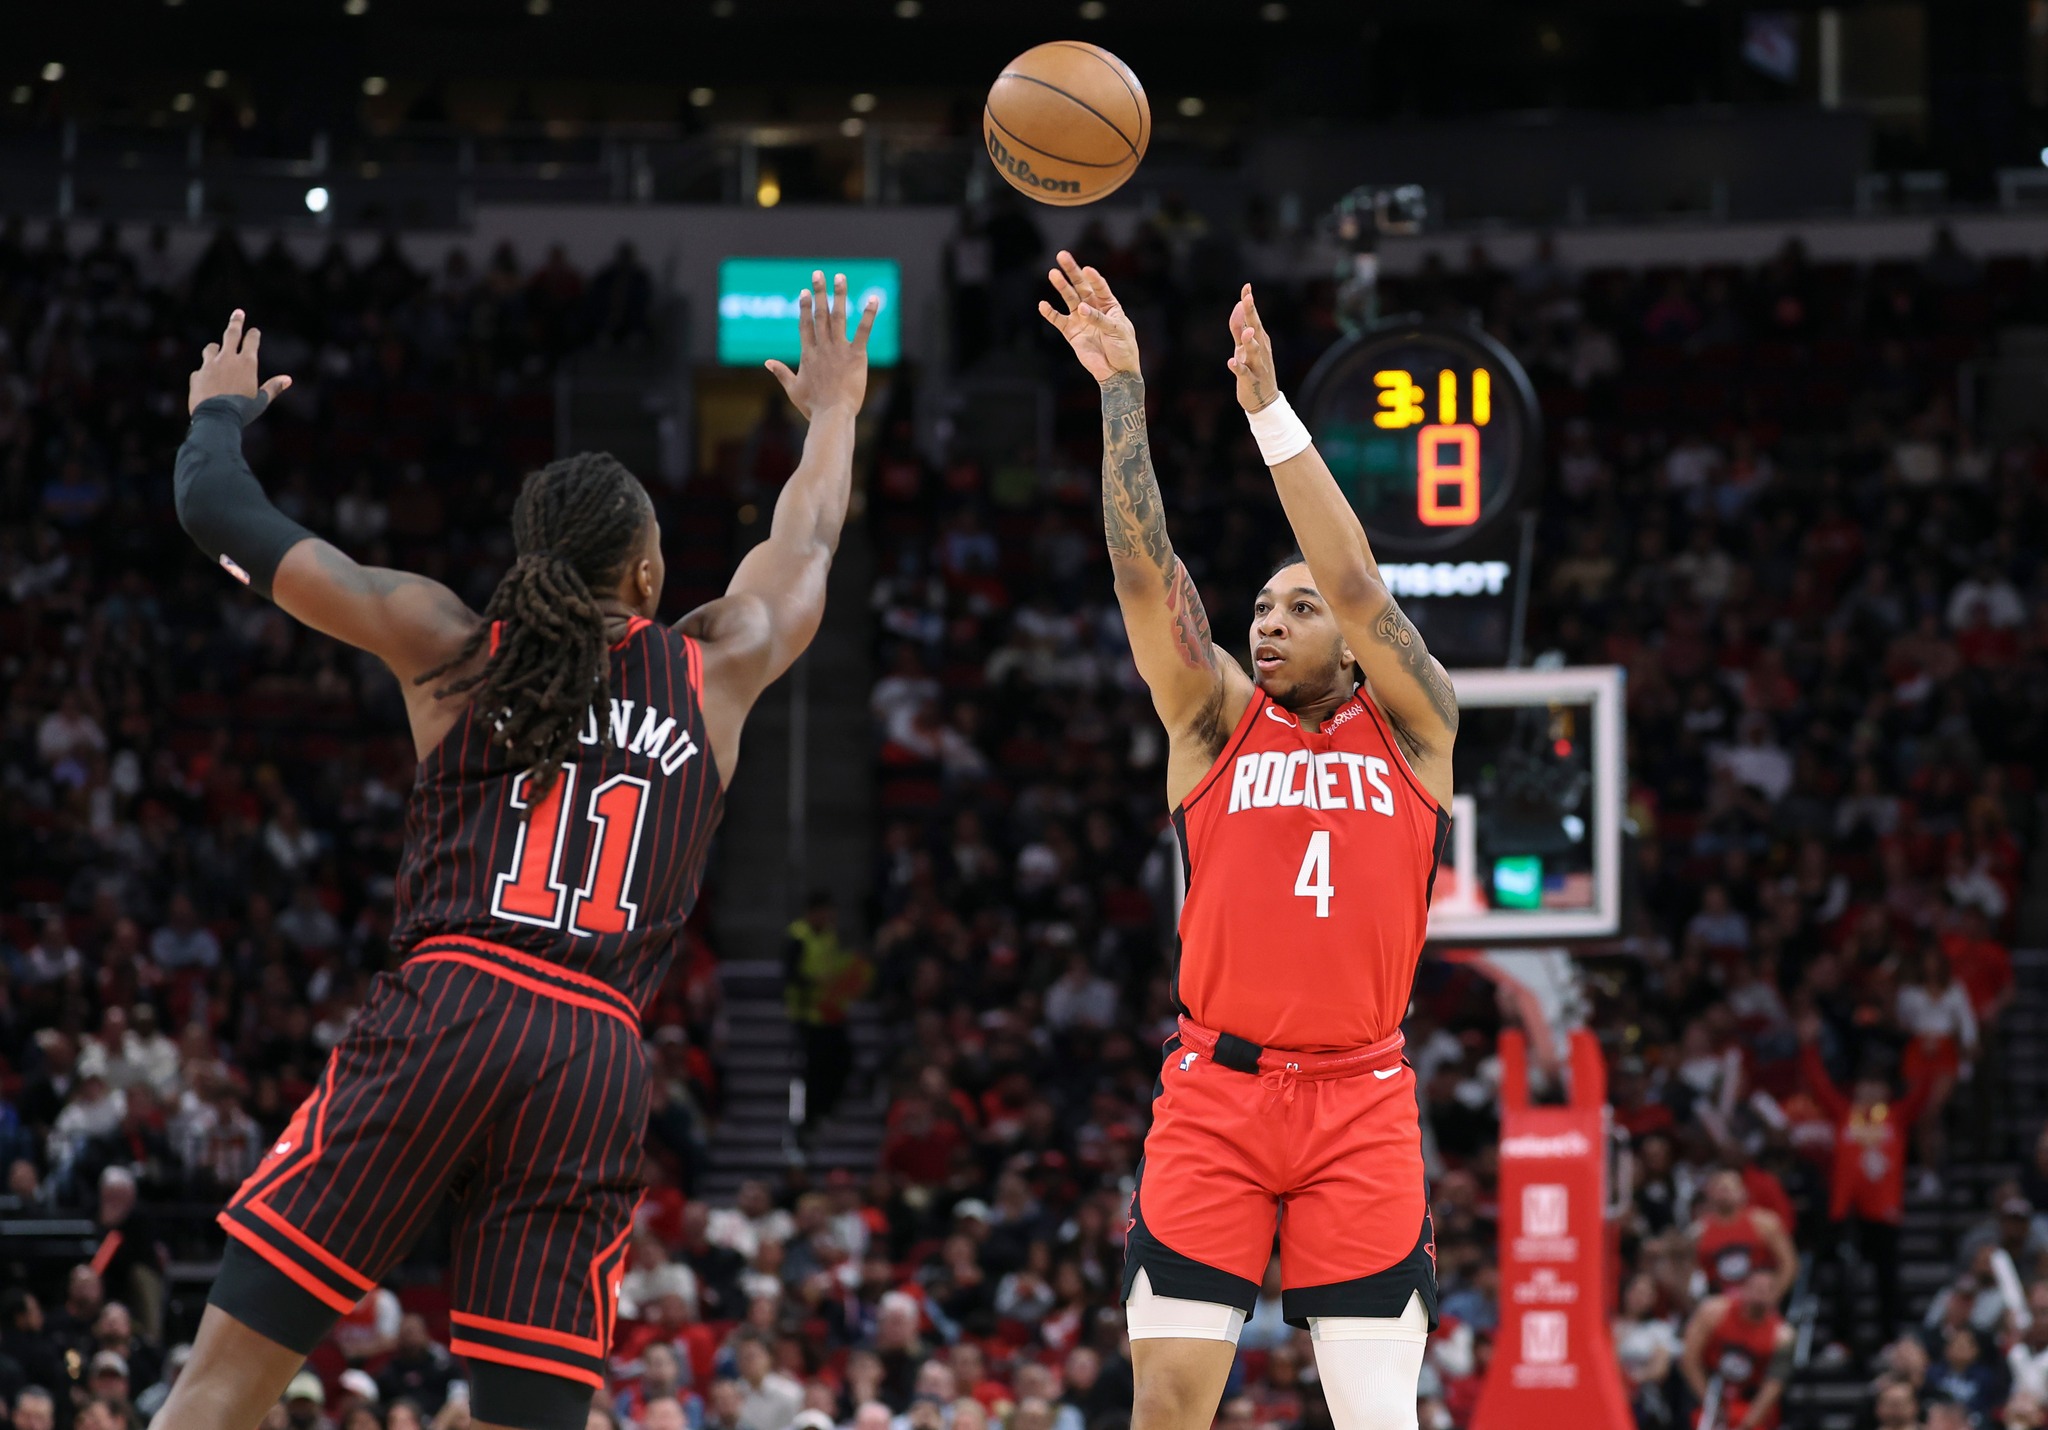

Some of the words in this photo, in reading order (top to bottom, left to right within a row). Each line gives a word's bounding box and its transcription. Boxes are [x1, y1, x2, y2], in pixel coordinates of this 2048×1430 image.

[989, 128, 1081, 194] Wilson
[1373, 368, 1491, 429] 3:11
[1417, 423, 1480, 526] 8
[1228, 749, 1395, 817] ROCKETS
[490, 761, 652, 938] 11
[1294, 830, 1335, 918] 4
